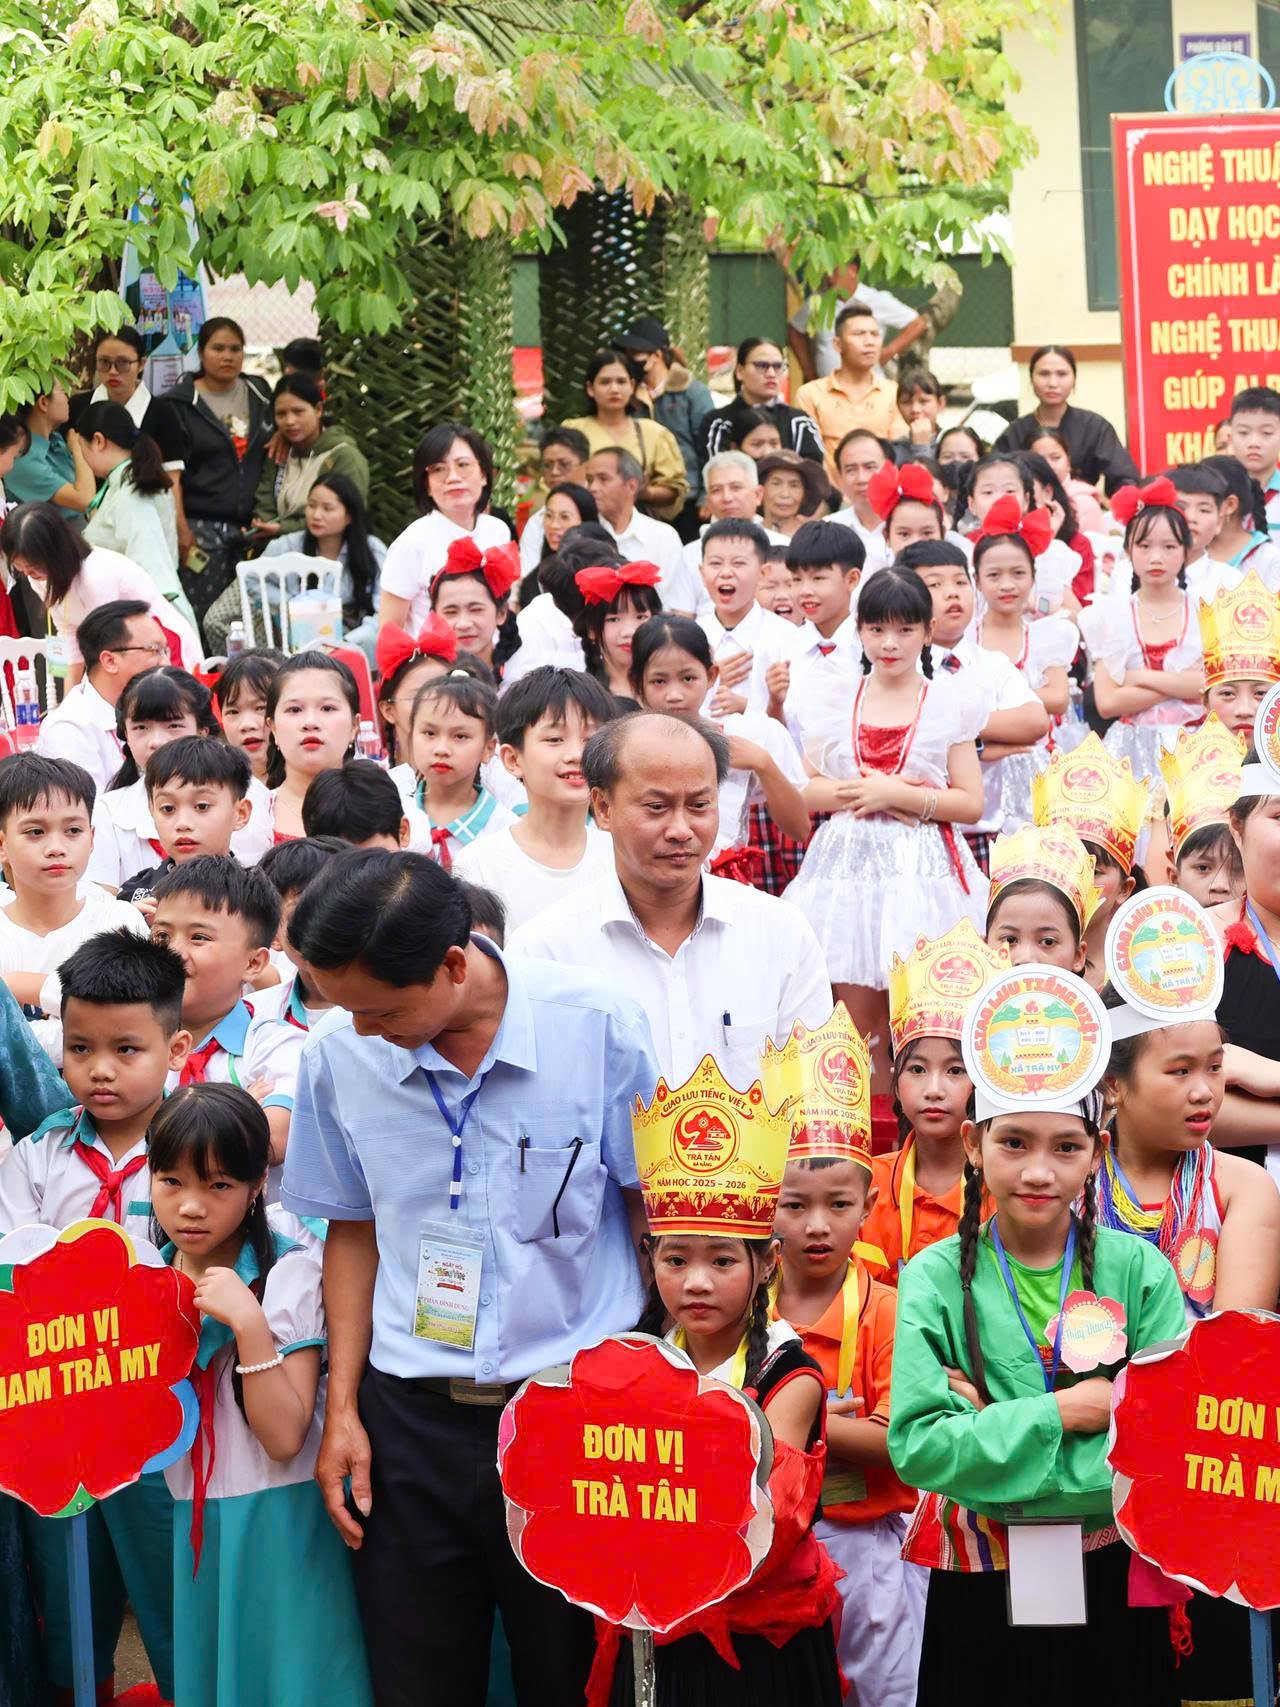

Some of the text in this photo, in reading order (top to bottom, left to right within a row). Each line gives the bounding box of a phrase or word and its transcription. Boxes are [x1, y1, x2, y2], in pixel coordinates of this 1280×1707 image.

[1143, 143, 1214, 192] NGHỆ
[1169, 206, 1221, 248] DẠY
[1168, 256, 1249, 298] CHÍNH
[1151, 313, 1222, 360] NGHỆ
[1164, 369, 1225, 410] GIÚP
[1166, 424, 1217, 465] KHÁ
[1124, 903, 1154, 932] LƯU
[1154, 896, 1197, 923] TIẾNG
[1116, 930, 1133, 971] GIAO
[974, 976, 1100, 1051] GIAO LƯU TIẾNG VIỆT
[802, 1036, 821, 1050] GIAO
[822, 1031, 837, 1040] LƯU
[1011, 1062, 1061, 1074] XÃ TRÀ MY
[662, 1087, 748, 1112] GIAO LƯU TIẾNG VIỆT
[800, 1107, 819, 1116] NĂM
[687, 1152, 721, 1161] TRÀ TÂN
[657, 1177, 671, 1187] NĂM
[672, 1178, 691, 1188] HỌC
[692, 1178, 716, 1187] 2025
[725, 1180, 746, 1189] 2026
[27, 1306, 119, 1357] ĐƠN VỊ
[59, 1350, 113, 1397] TRÀ
[119, 1343, 161, 1383] MY
[1196, 1394, 1266, 1439] ĐƠN
[583, 1423, 684, 1473] ĐƠN VỊ
[1184, 1453, 1245, 1498] TRÀ
[572, 1475, 697, 1523] TRÀ TÂN
